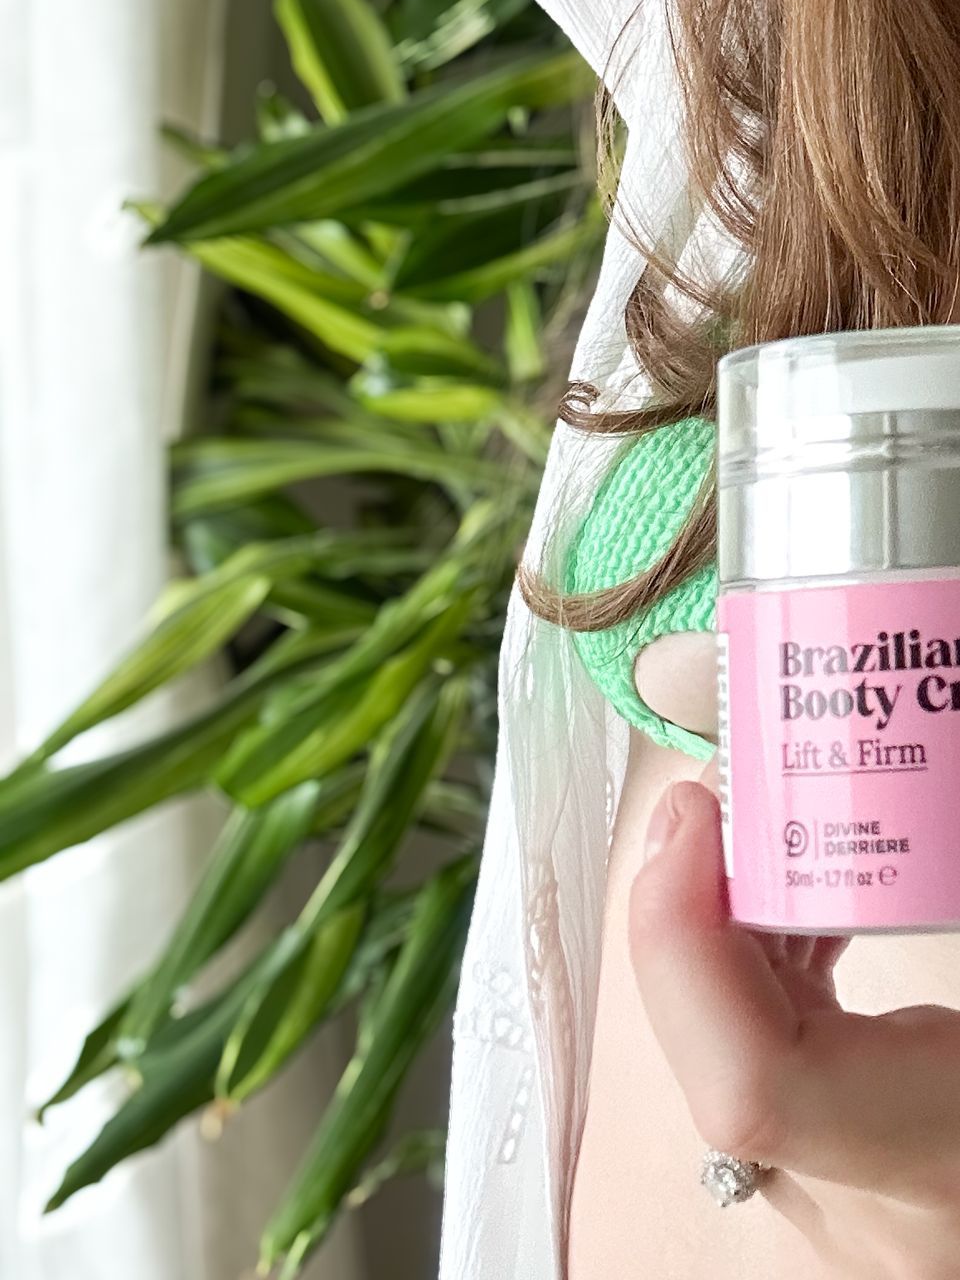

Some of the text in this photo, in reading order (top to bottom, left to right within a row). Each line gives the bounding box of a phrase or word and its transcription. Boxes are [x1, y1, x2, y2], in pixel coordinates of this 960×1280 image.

[780, 677, 901, 730] Booty
[782, 738, 927, 770] Lift & Firm
[823, 821, 881, 837] DIVINE
[856, 871, 873, 886] oz
